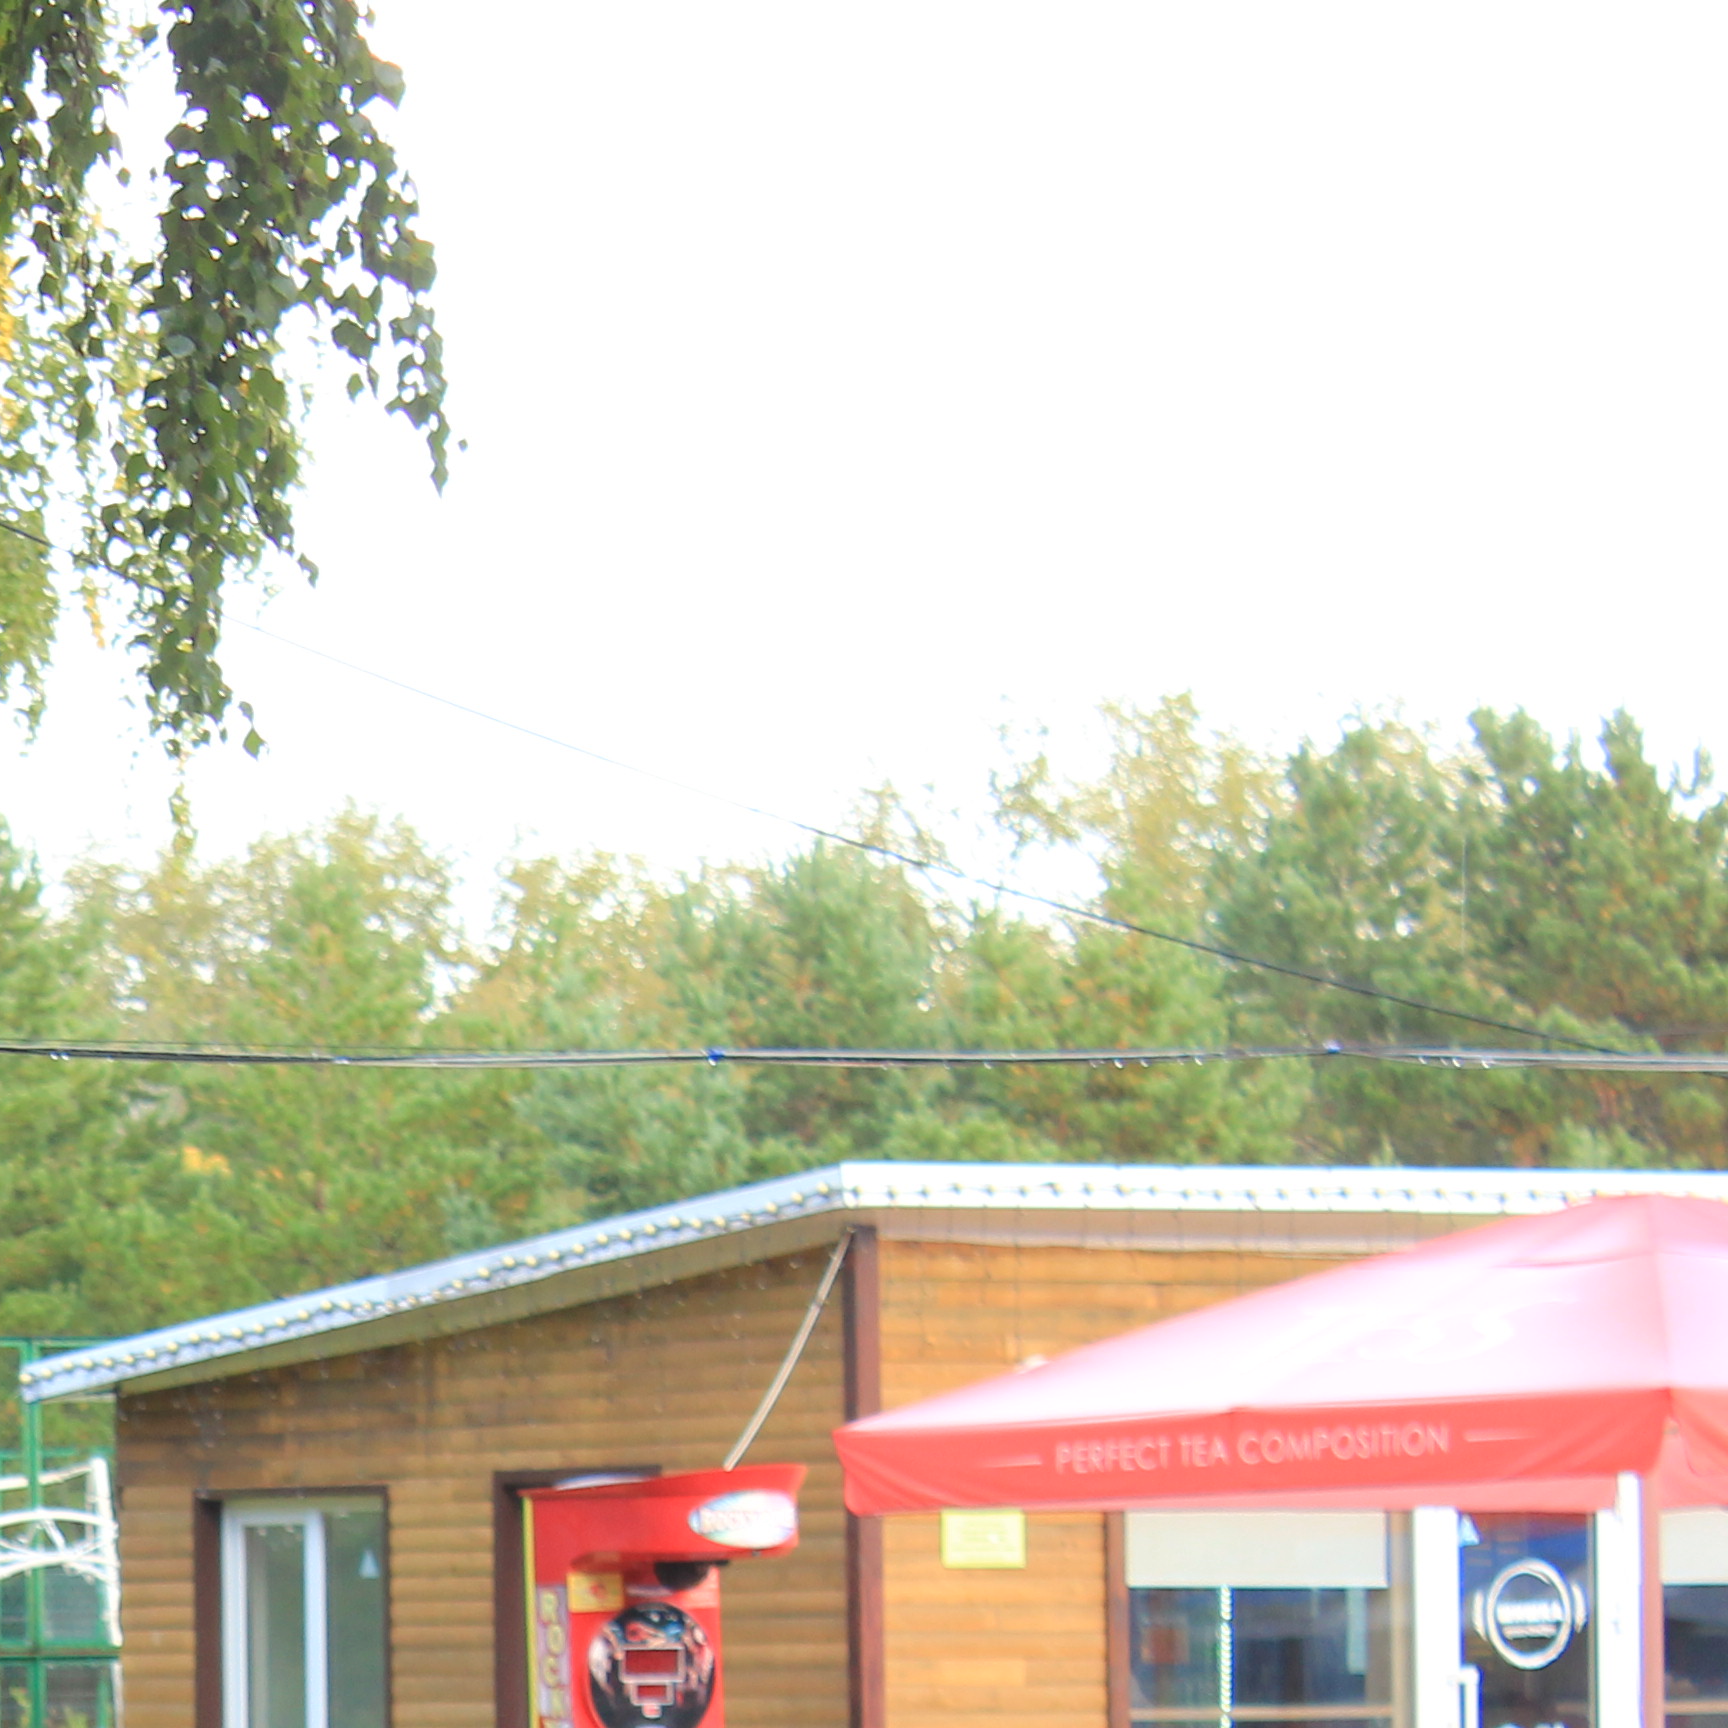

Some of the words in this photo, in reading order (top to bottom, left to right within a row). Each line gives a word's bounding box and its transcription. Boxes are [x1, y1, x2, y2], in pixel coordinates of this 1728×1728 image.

[1055, 1438, 1171, 1475] PERFECT
[1179, 1434, 1230, 1468] TEA
[1237, 1422, 1451, 1465] COMPOSITION
